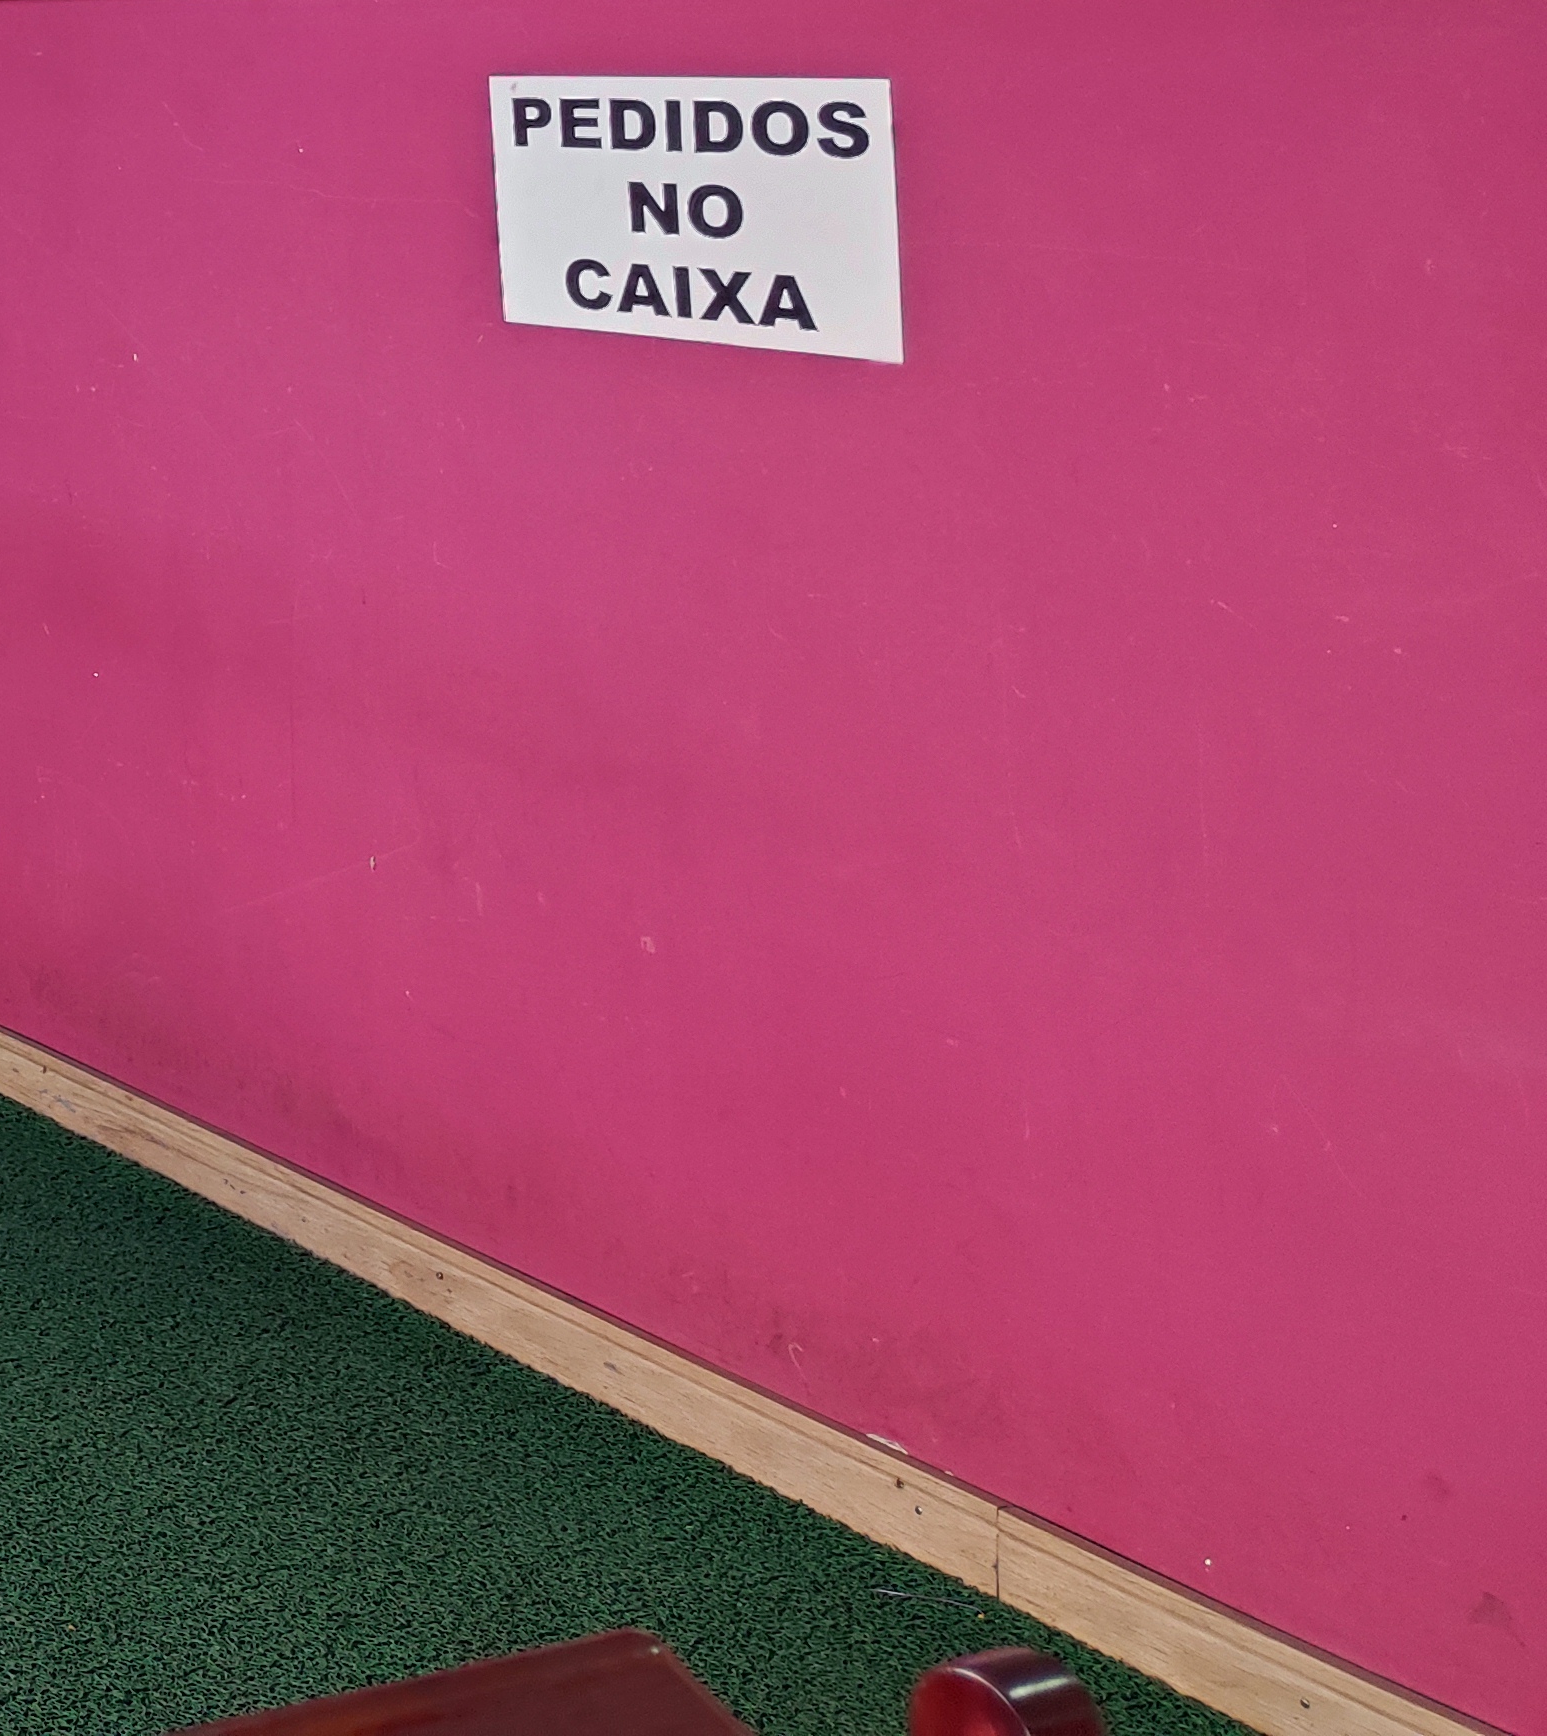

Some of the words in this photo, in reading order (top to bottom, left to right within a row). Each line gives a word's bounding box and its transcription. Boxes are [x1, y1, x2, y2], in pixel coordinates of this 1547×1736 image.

[511, 97, 871, 159] PEDIDOS
[627, 181, 745, 239] NO
[565, 258, 819, 332] CAIXA
